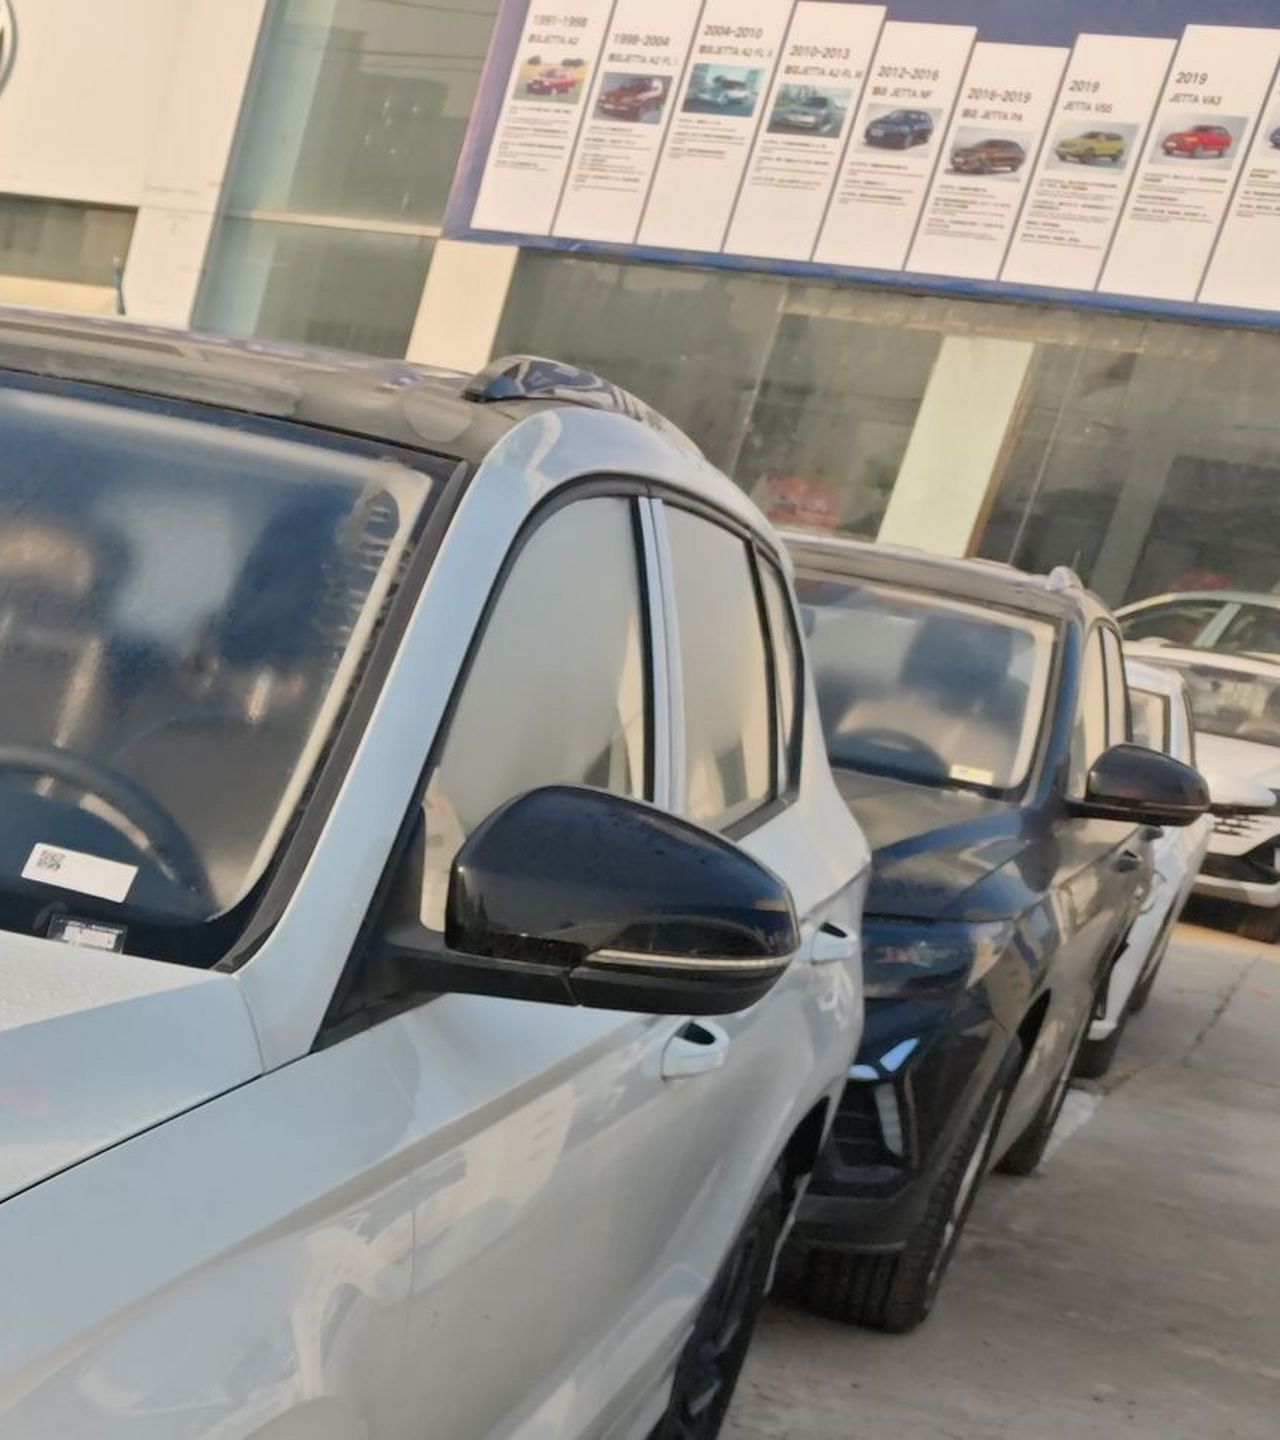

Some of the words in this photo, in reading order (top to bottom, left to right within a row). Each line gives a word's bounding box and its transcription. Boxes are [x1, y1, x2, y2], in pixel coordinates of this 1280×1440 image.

[1175, 71, 1208, 86] 2019
[1068, 79, 1100, 94] 2019
[1062, 100, 1092, 112] JETTA
[1169, 92, 1201, 105] JETTA
[1202, 94, 1223, 107] VA3
